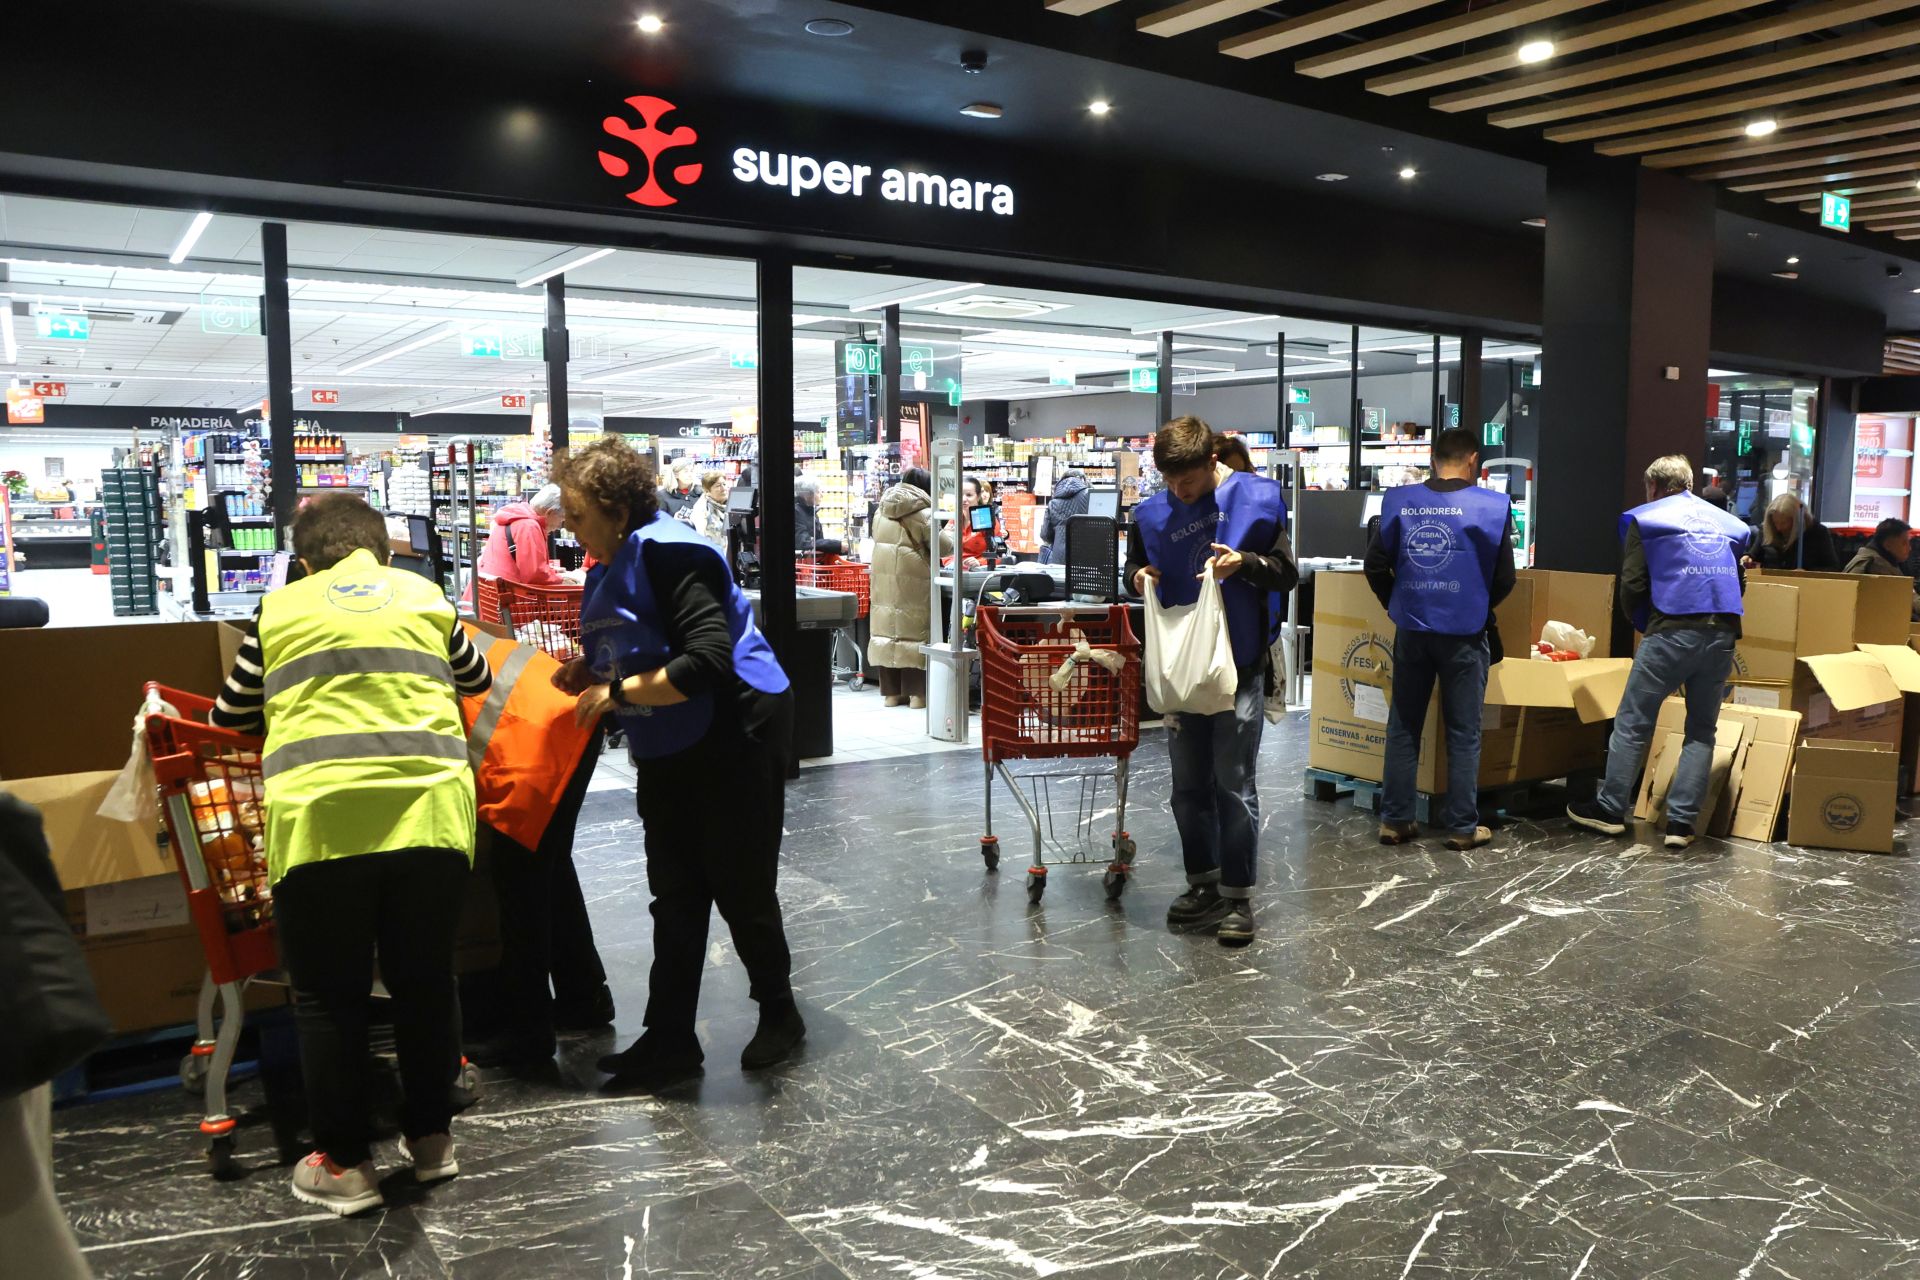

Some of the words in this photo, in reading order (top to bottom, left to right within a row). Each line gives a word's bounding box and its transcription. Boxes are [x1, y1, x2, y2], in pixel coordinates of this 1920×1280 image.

[732, 146, 871, 197] super
[881, 167, 1015, 216] amara
[1401, 507, 1463, 516] BOLONDRESA
[1321, 726, 1360, 740] CONSERVAS
